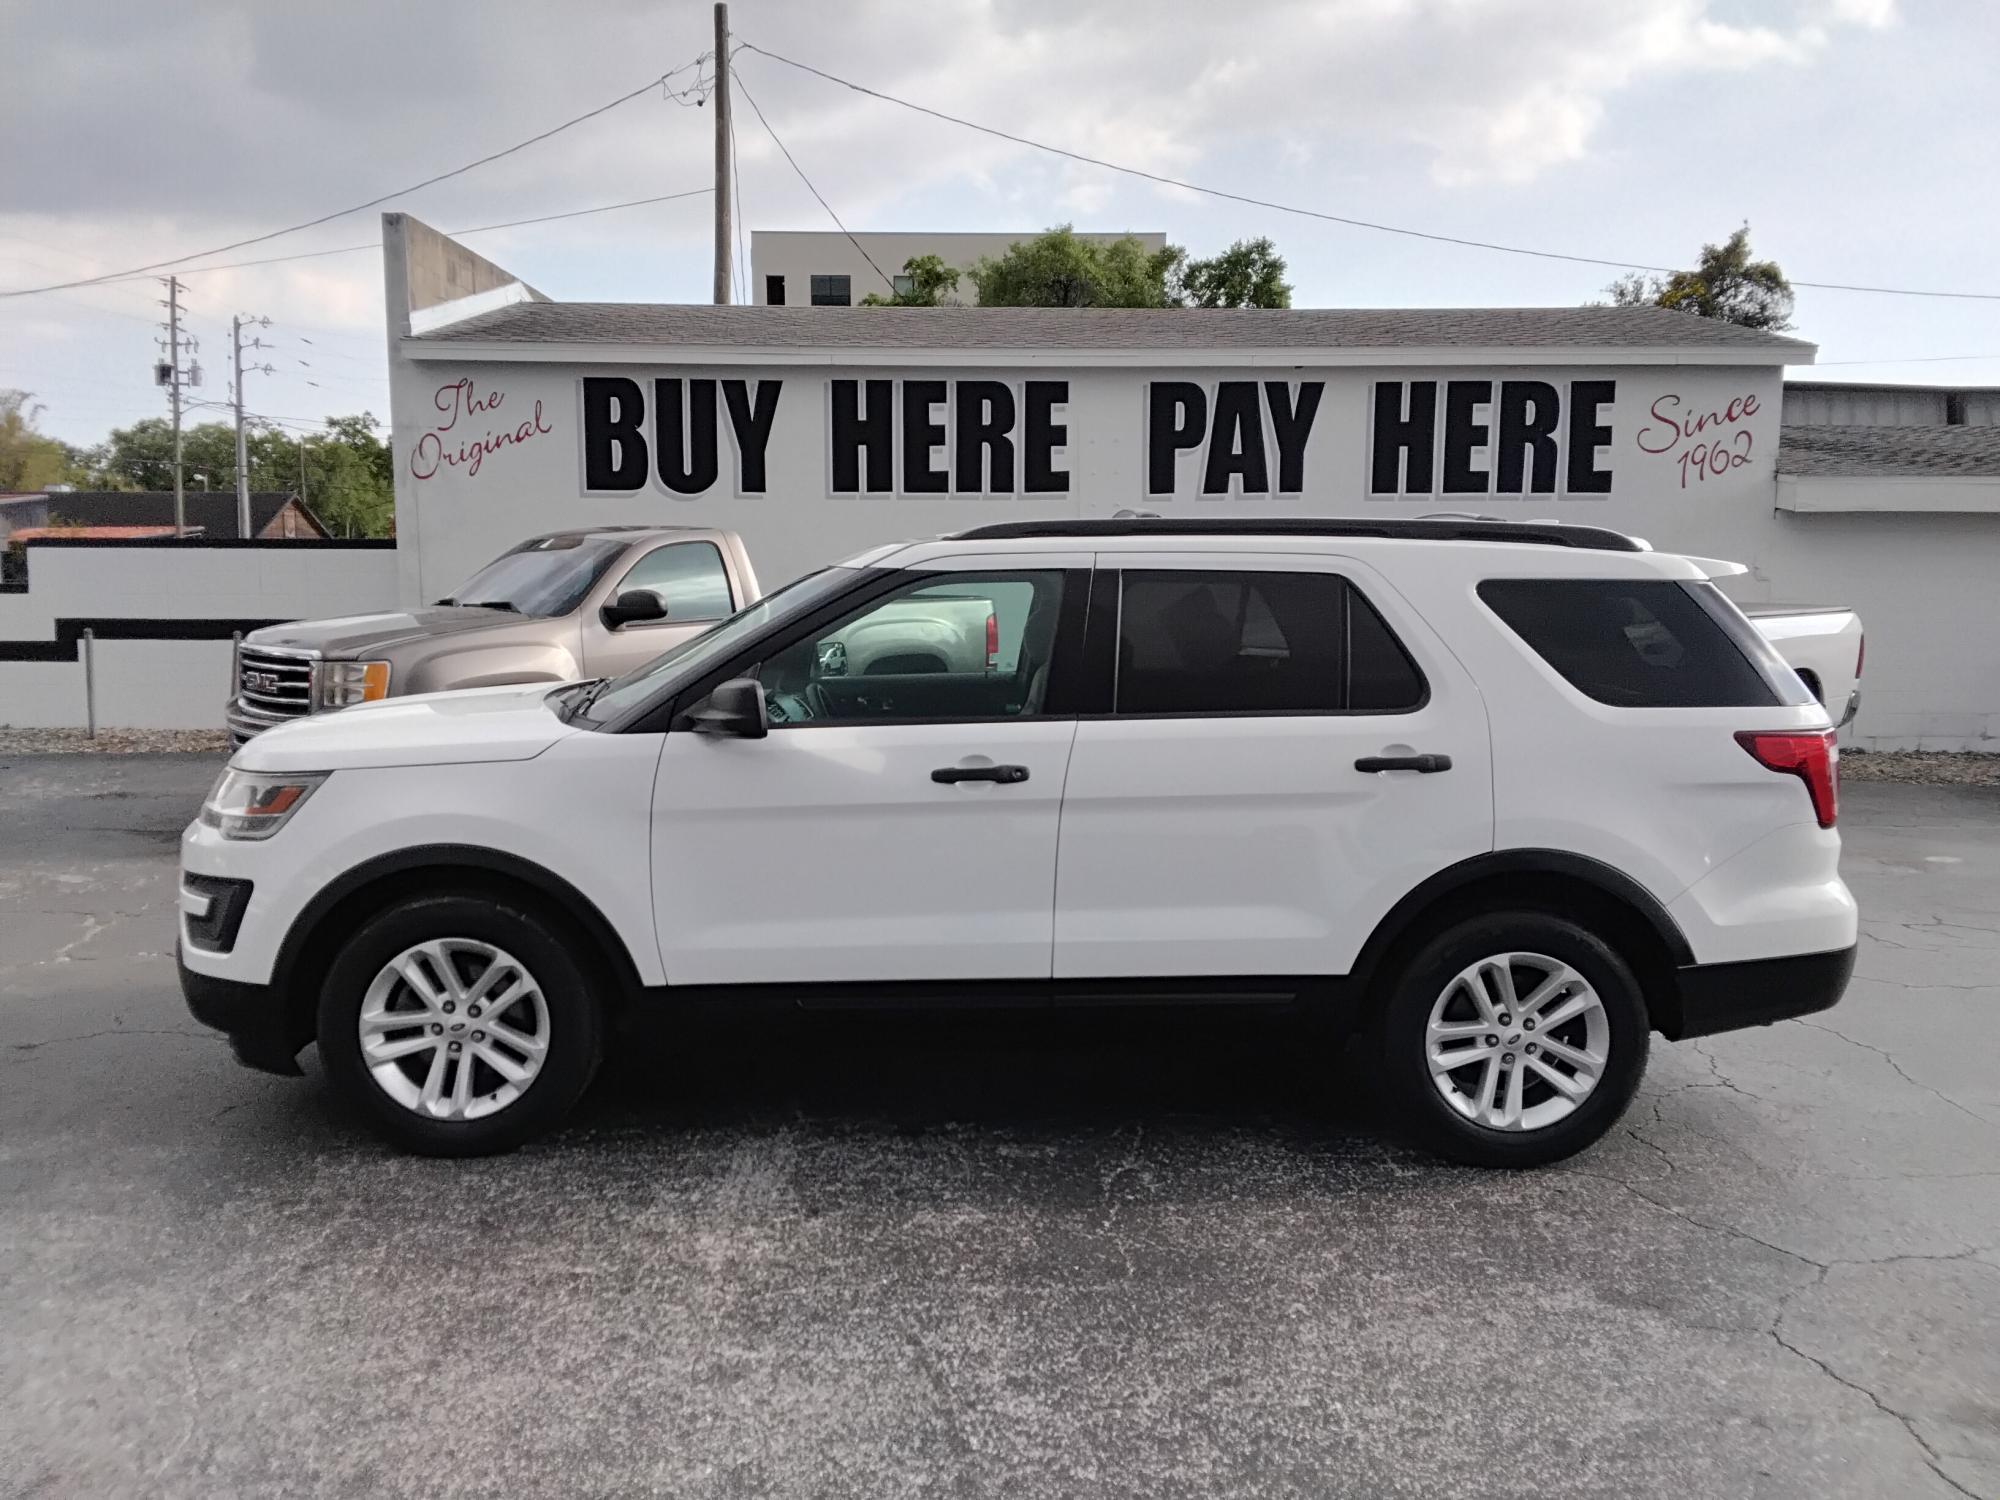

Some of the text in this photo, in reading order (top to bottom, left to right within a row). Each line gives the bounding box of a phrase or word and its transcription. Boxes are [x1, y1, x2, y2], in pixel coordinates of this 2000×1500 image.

[434, 377, 505, 432] The
[1637, 393, 1761, 454] Since
[410, 400, 552, 480] Original
[581, 376, 1616, 496] BUY HERE PAY HERE
[1677, 430, 1753, 489] 1962
